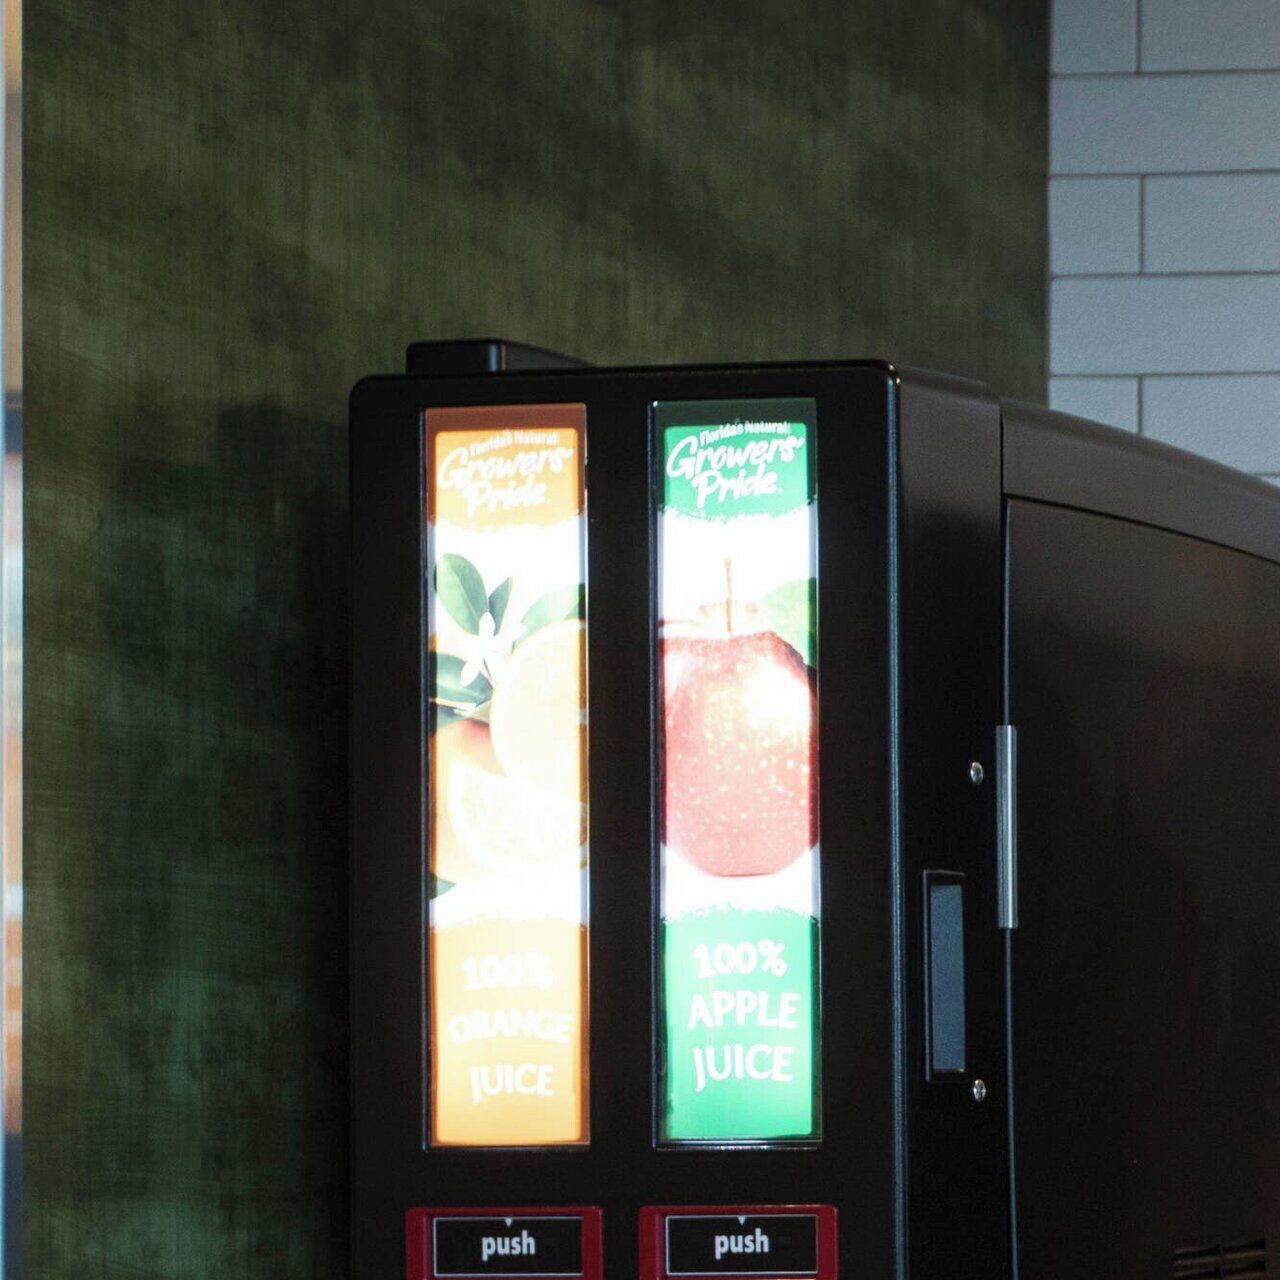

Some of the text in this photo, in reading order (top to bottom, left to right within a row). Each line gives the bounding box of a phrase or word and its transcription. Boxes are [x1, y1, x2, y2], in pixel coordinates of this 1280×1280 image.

[460, 951, 556, 991] 100%
[693, 938, 787, 978] 100%
[448, 1010, 573, 1044] ORANGE
[687, 990, 801, 1030] APPLE
[469, 1062, 556, 1104] JUICE
[692, 1043, 793, 1092] JUICE
[481, 1231, 536, 1262] push
[715, 1228, 769, 1259] push
